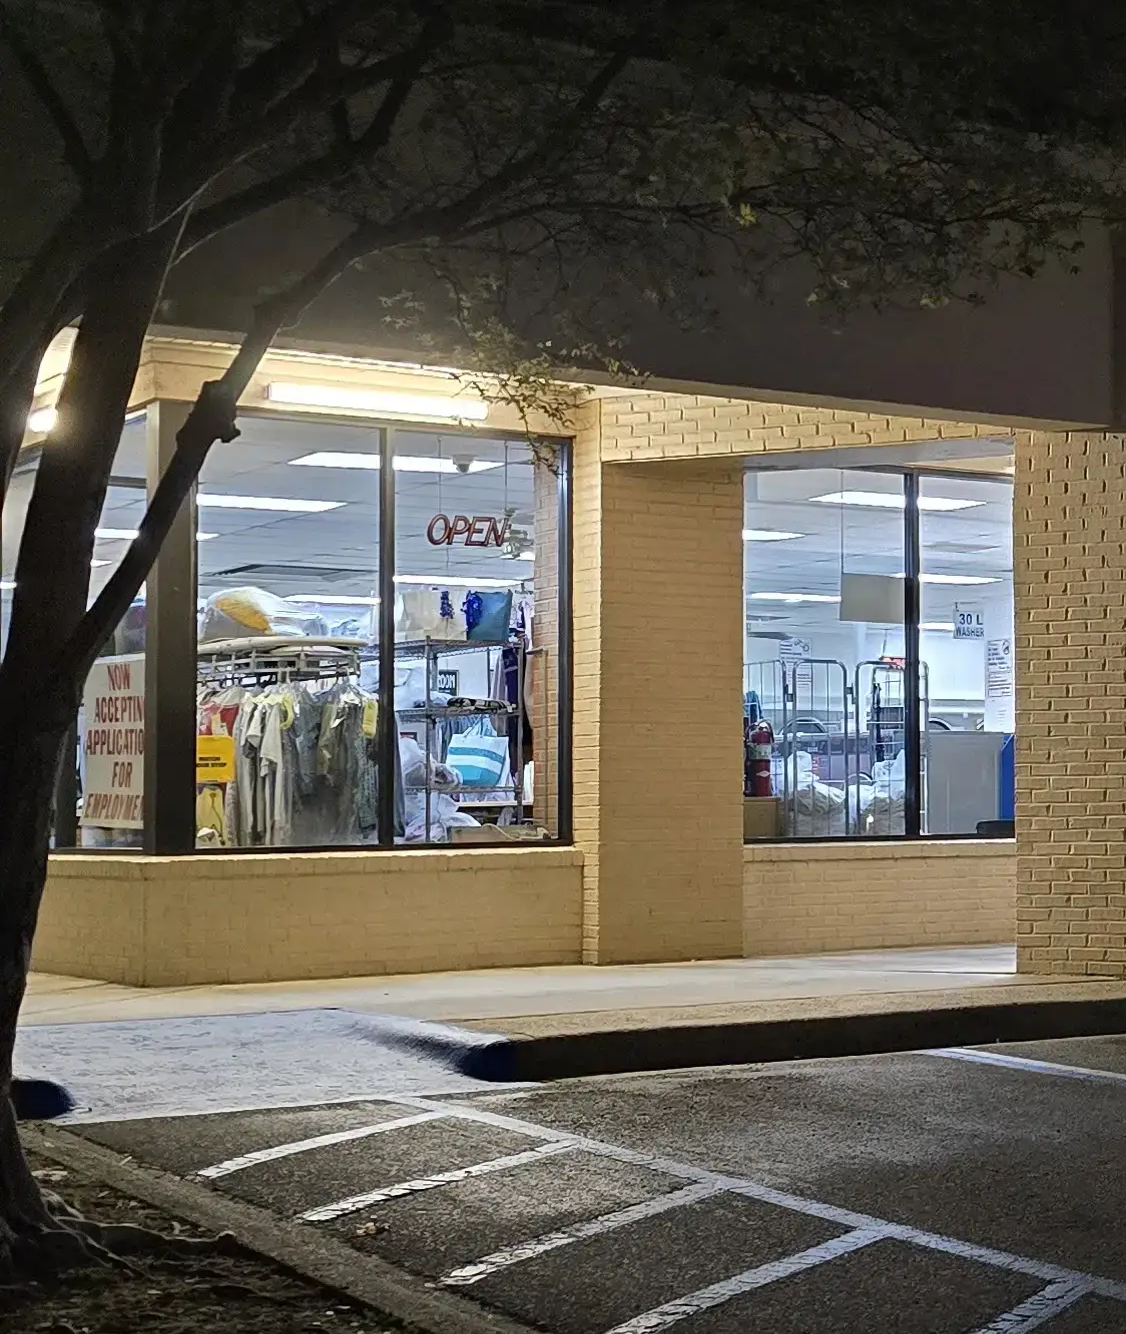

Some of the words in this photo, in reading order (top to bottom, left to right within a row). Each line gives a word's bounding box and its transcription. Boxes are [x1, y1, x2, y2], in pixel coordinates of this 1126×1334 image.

[427, 513, 509, 547] OPEN
[959, 613, 972, 625] 30
[107, 663, 131, 691] NOW
[94, 695, 145, 723] ACCEPTIN
[111, 761, 133, 788] FOR
